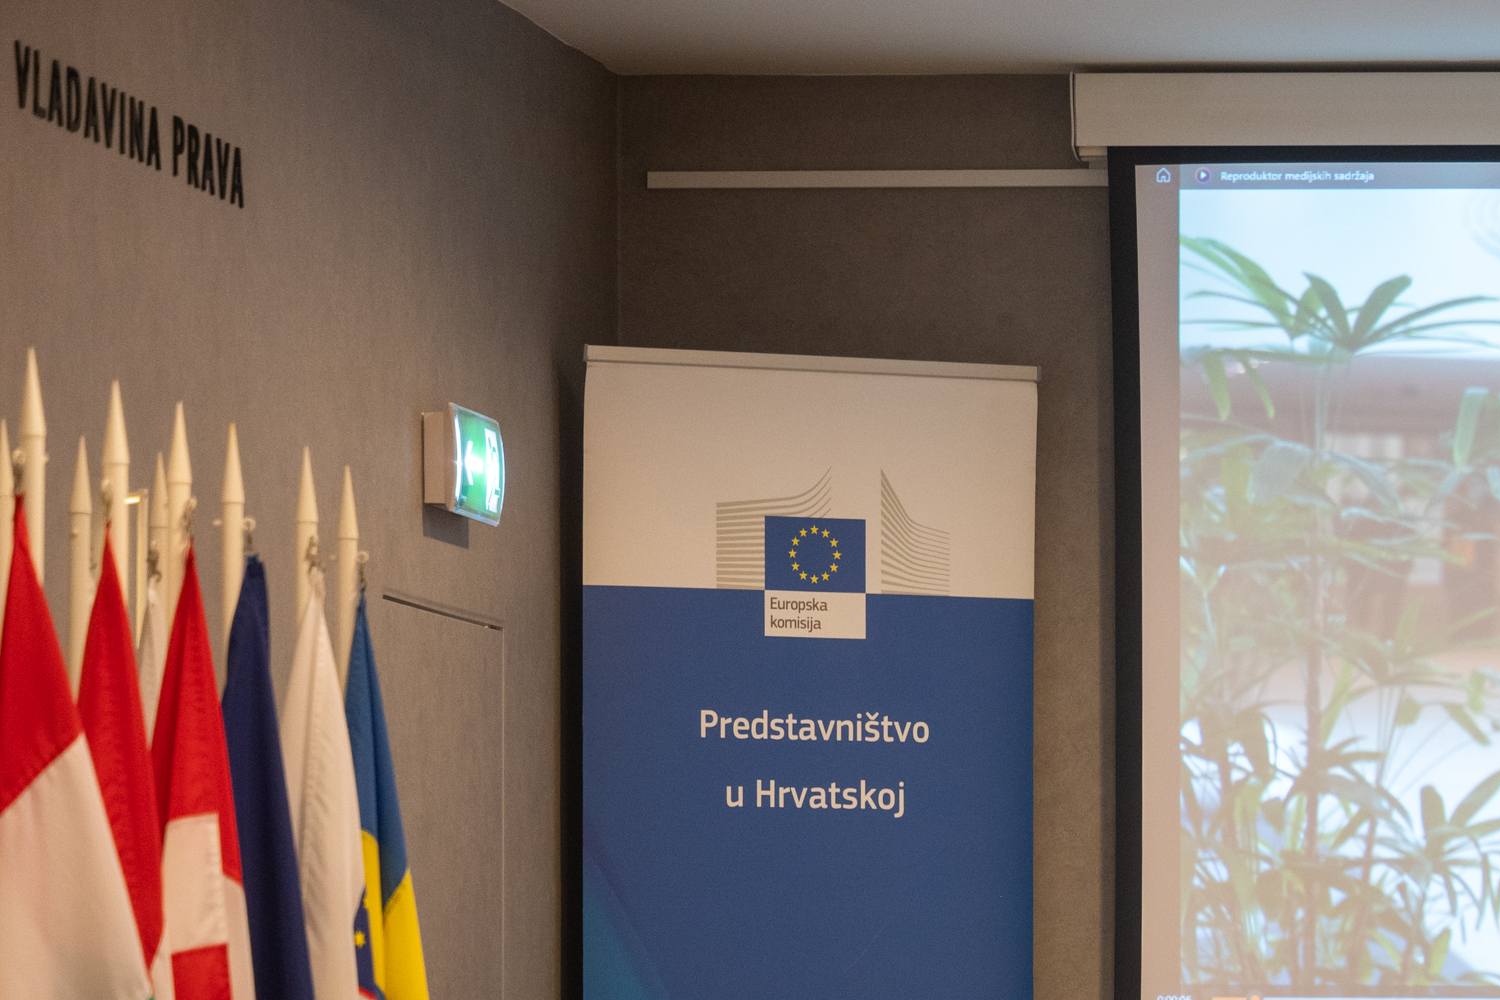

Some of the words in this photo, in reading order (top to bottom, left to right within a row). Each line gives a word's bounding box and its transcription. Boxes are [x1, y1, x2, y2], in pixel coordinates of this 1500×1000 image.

[14, 39, 162, 171] VLADAVINA
[172, 114, 244, 209] PRAVA
[1220, 171, 1282, 183] Reproduktor
[1285, 171, 1332, 183] medijskih
[1334, 171, 1375, 183] sadržaja
[770, 597, 828, 613] Europska
[770, 615, 822, 632] komisija
[700, 709, 930, 743] Predstavništvo
[726, 785, 744, 807] u
[756, 779, 905, 818] Hrvatskoj
